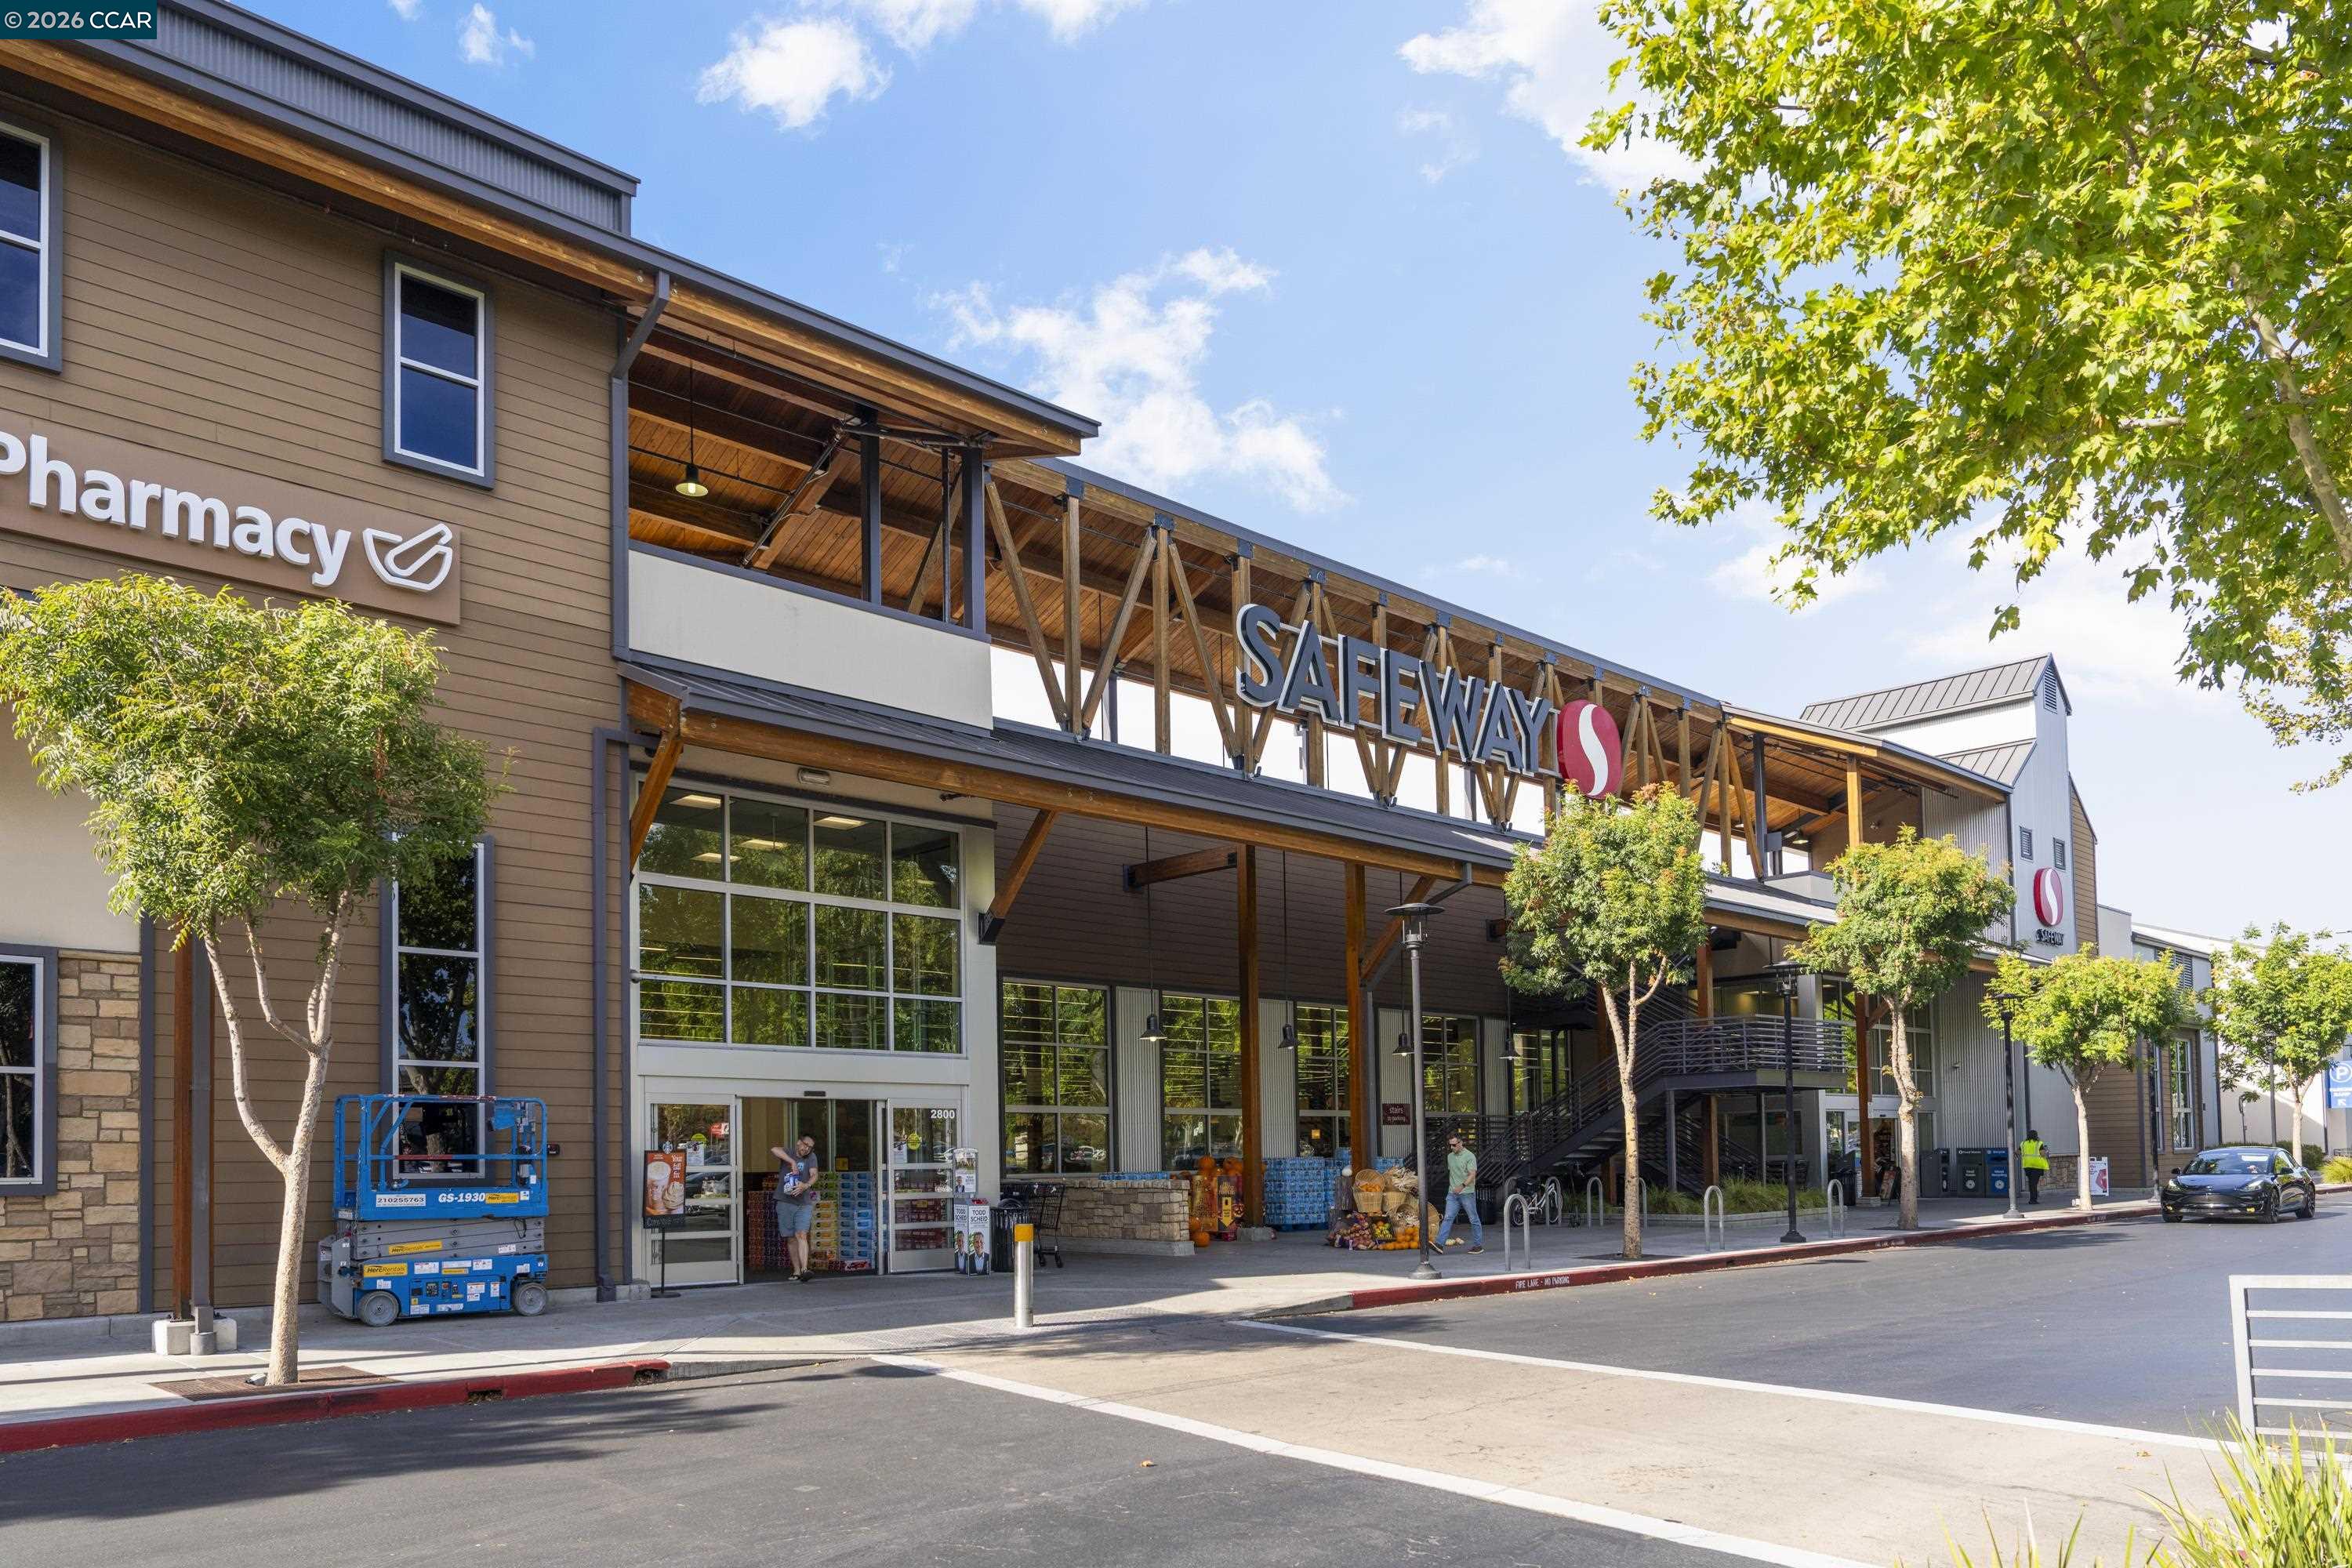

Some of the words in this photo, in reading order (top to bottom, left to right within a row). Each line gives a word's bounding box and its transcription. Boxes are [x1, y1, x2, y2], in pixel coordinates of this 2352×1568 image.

[1236, 603, 1552, 777] SAFEWAY
[931, 1109, 956, 1119] 2800
[438, 1192, 485, 1203] GS-1930
[1515, 1279, 1526, 1289] FIRE
[1528, 1279, 1539, 1287] LANE
[1544, 1276, 1552, 1286] NO
[1552, 1276, 1570, 1285] PARKING
